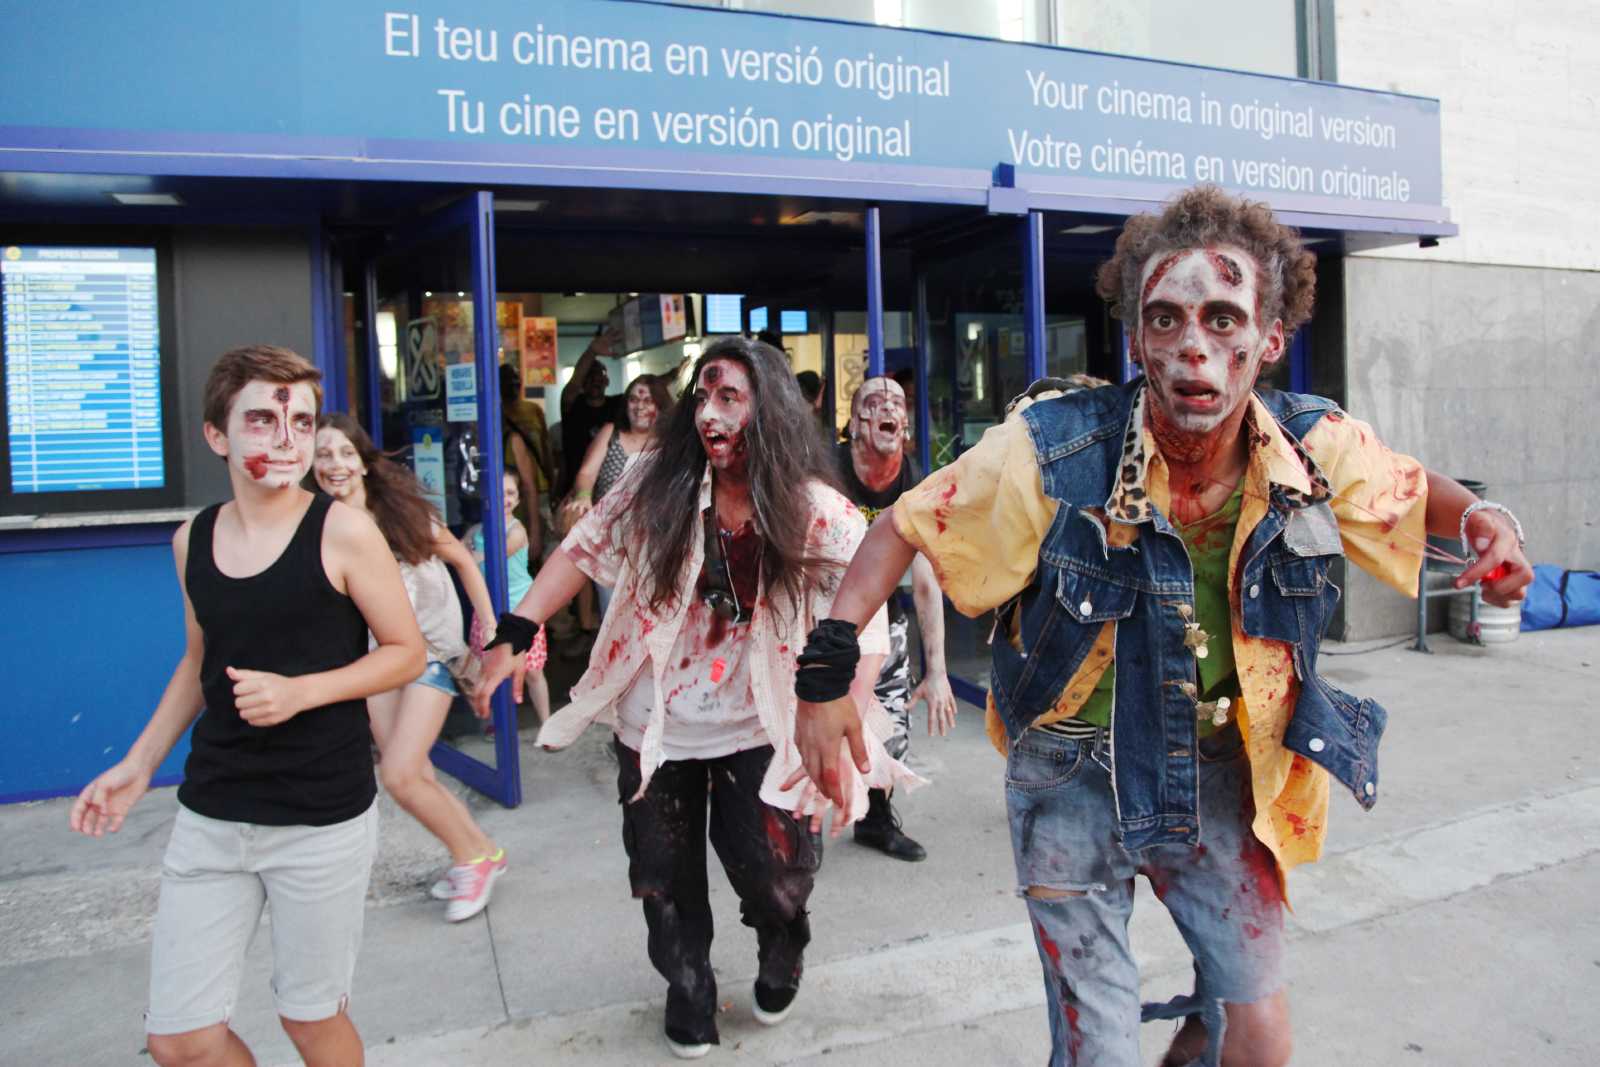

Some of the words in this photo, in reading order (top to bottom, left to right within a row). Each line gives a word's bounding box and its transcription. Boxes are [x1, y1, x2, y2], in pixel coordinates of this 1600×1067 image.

[384, 11, 420, 57] El
[433, 17, 498, 62] teu
[512, 22, 653, 73] cinema
[664, 43, 708, 76] en
[720, 45, 823, 86] versió
[834, 53, 951, 100] original
[437, 89, 485, 134] Tu
[499, 94, 580, 138] cine
[594, 107, 639, 140] en
[651, 106, 779, 148] versión
[792, 113, 911, 162] original
[1026, 70, 1088, 111] Your
[1097, 80, 1192, 123] cinema
[1201, 92, 1221, 126] in
[1230, 99, 1313, 140] original
[1320, 115, 1396, 149] version
[1008, 128, 1082, 169] Votre
[1091, 138, 1186, 179] cinéma
[1195, 155, 1224, 182] en
[1232, 160, 1313, 193] version
[1321, 165, 1411, 203] originale
